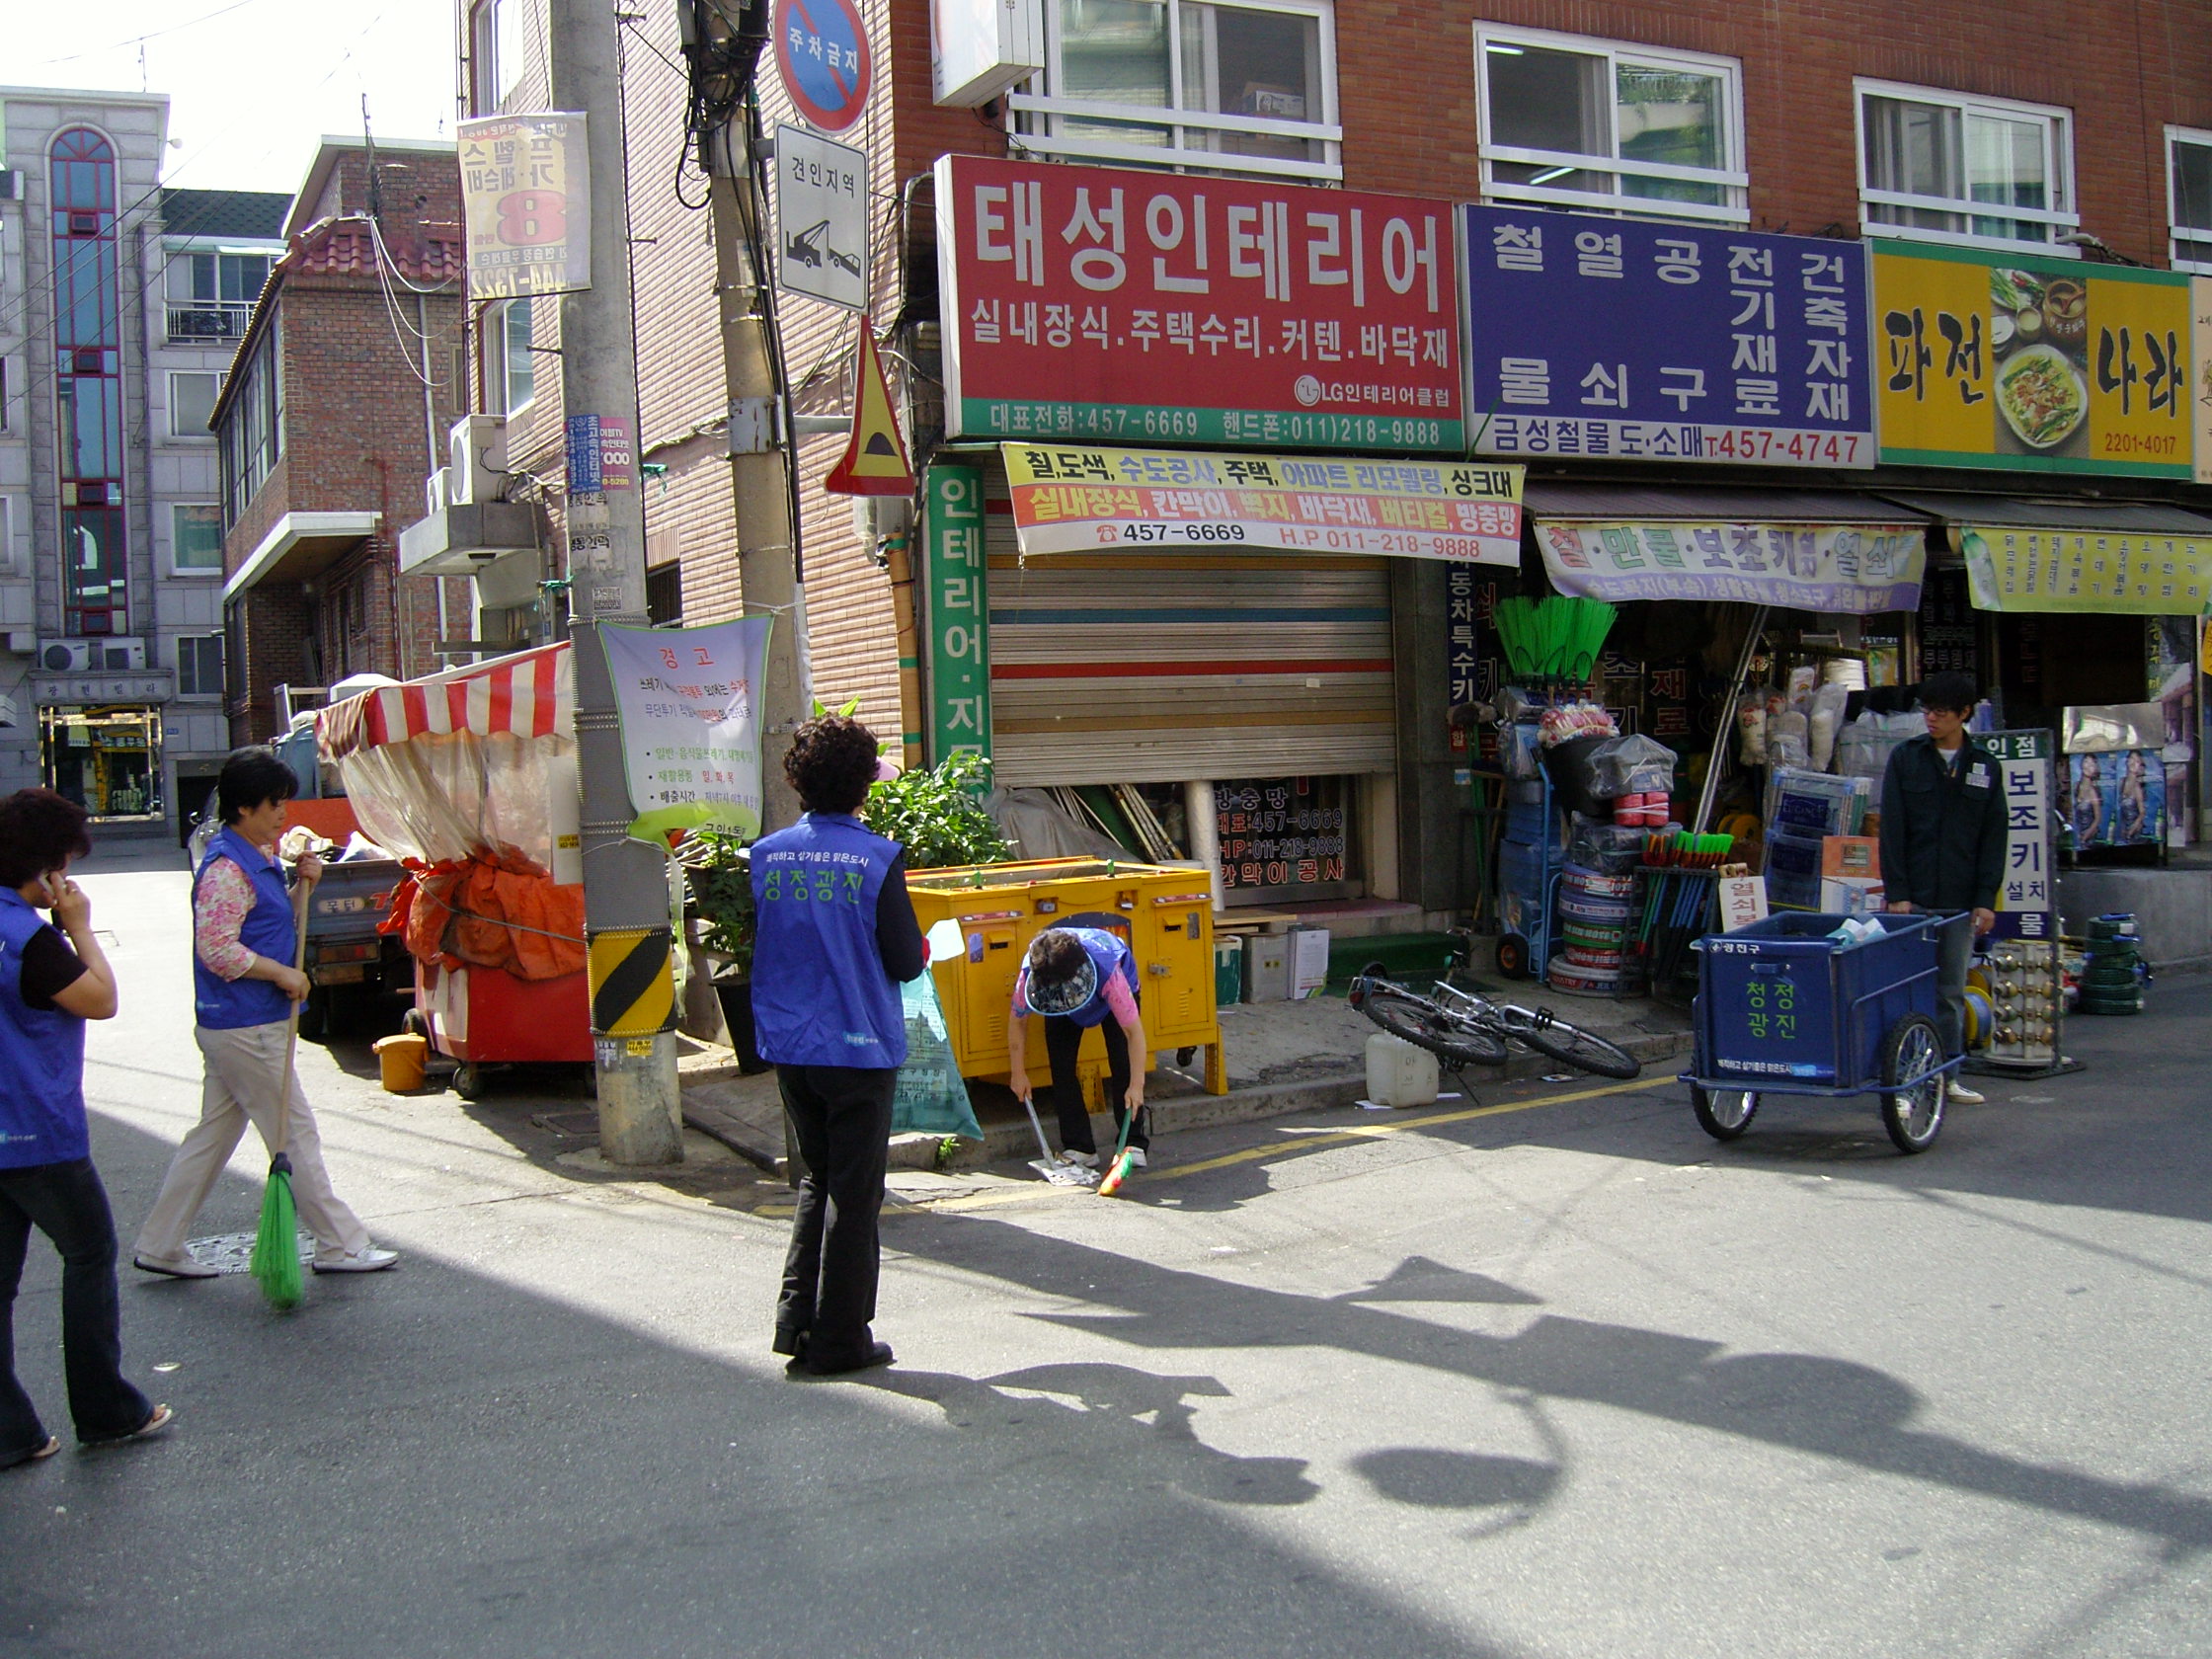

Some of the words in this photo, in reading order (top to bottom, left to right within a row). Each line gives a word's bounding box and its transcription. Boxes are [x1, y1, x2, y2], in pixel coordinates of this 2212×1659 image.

[789, 27, 859, 75] 주차금지
[792, 156, 854, 198] 견인지역
[974, 181, 1439, 313] 태성인테리어
[1727, 245, 1780, 416] 전기재료
[1800, 252, 1853, 423] 건축자재
[1884, 307, 1985, 406] 파전
[2097, 325, 2184, 419] 나라
[1493, 417, 1611, 455] 금성철물
[2104, 433, 2176, 455] 2201-4017
[1283, 461, 1350, 490] 아파트
[1451, 468, 1514, 498] 싱크대
[1457, 504, 1517, 536] 방충망
[1123, 522, 1246, 542] 457-6669
[1326, 530, 1480, 558] 011-218-9888
[660, 791, 695, 804] 배출시간
[1214, 787, 1289, 811] 방충망
[2008, 769, 2041, 871] 보조키
[2007, 880, 2045, 902] 설치
[1746, 981, 1795, 1010] 청정
[1747, 1011, 1796, 1039] 광진
